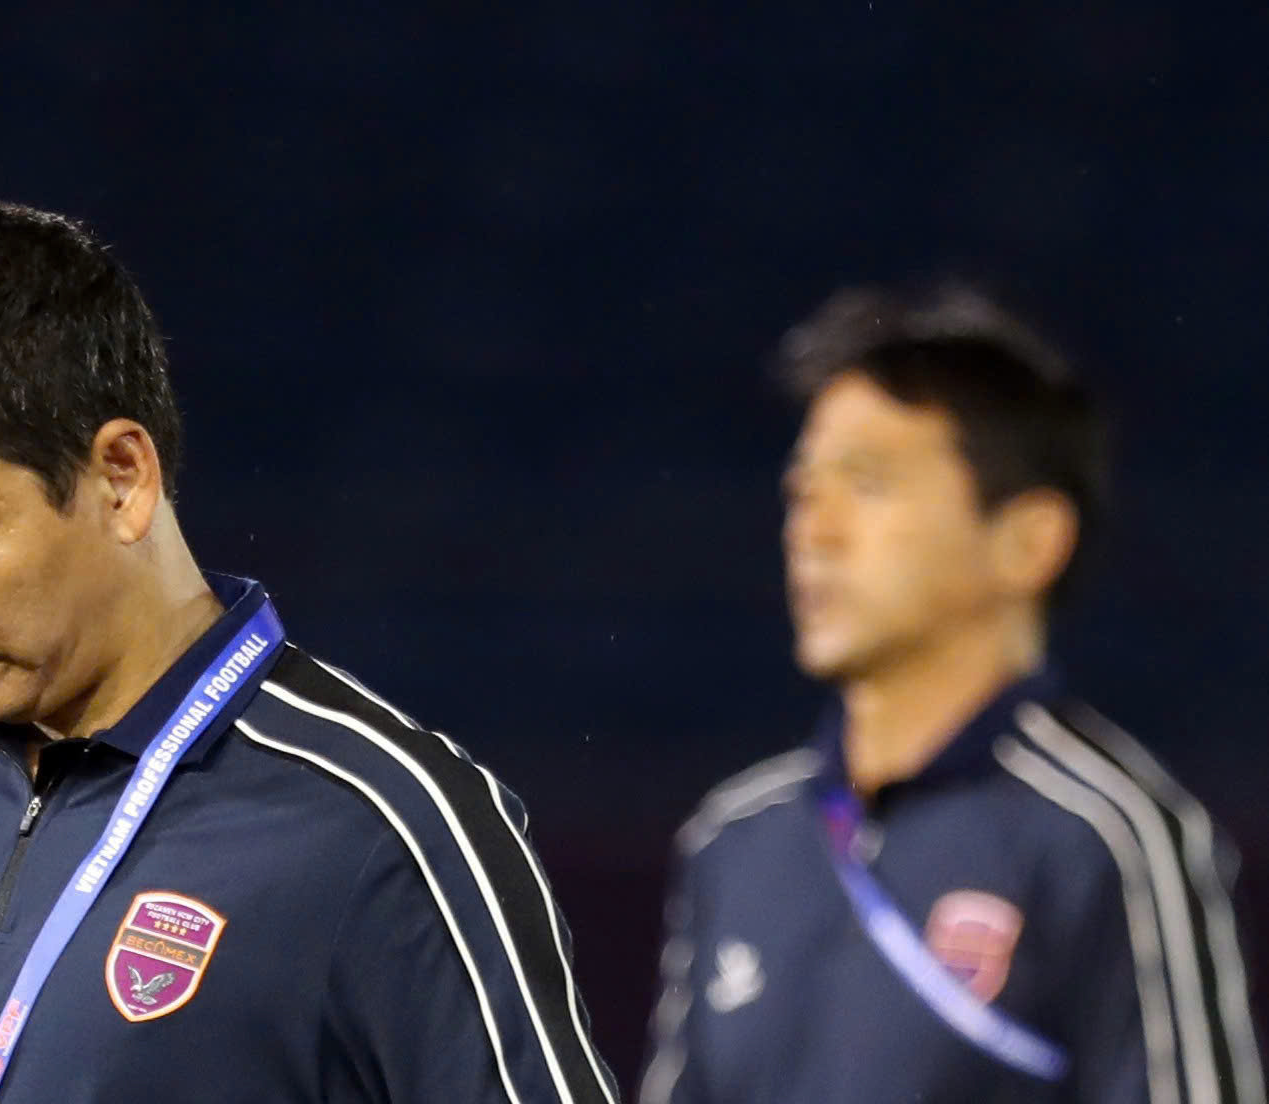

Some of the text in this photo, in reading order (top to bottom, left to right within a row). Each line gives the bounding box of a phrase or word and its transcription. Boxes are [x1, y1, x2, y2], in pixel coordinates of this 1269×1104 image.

[75, 633, 268, 893] VIETNAM PROFESSIONAL FOOTBALL
